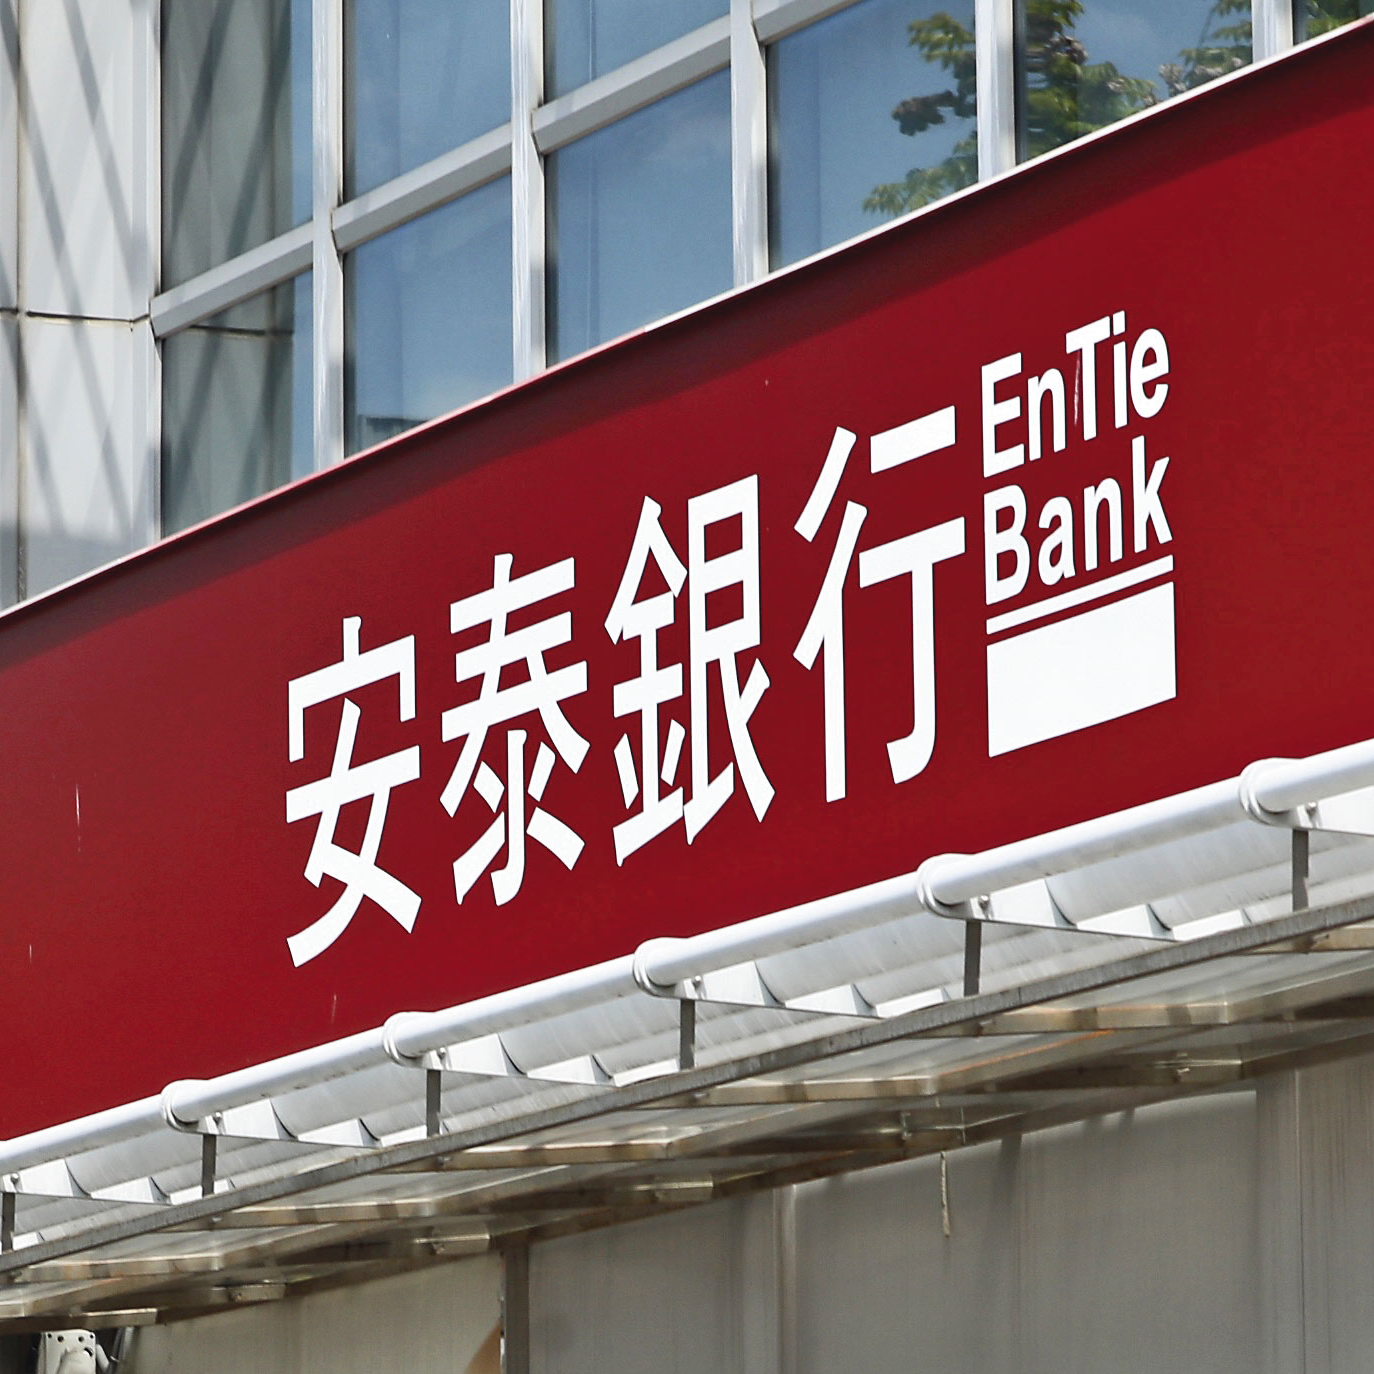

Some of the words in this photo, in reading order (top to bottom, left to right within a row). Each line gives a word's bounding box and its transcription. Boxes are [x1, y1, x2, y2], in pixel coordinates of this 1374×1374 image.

[981, 309, 1170, 479] EnTie
[983, 435, 1174, 605] Bank
[285, 404, 966, 968] 安泰銀行
